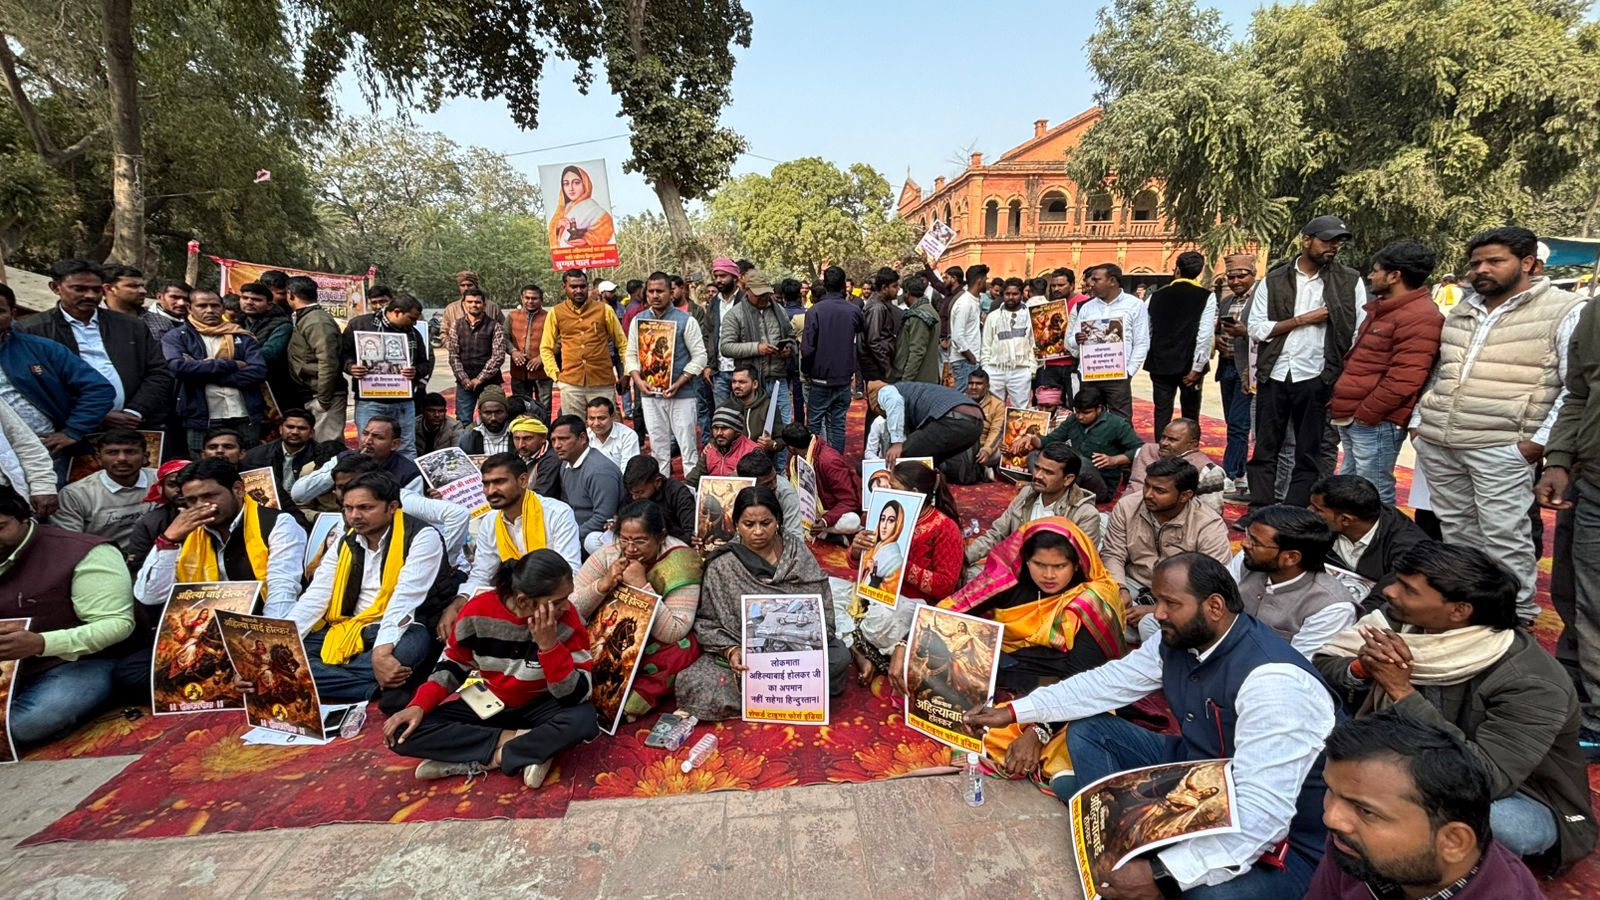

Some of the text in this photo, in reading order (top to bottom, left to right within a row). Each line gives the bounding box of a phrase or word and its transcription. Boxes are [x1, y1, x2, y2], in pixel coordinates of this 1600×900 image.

[176, 589, 206, 600] अहिल्या
[265, 623, 290, 634] होल्कर
[770, 658, 800, 667] लोकमाता
[750, 668, 821, 680] अहिल्याबाई होलकर जी
[768, 684, 802, 692] का अपमान
[751, 694, 819, 706] नहीं सहेगा हिन्दुस्तान।
[928, 714, 952, 728] होलकर
[1090, 793, 1104, 859] अहिल्याबाई
